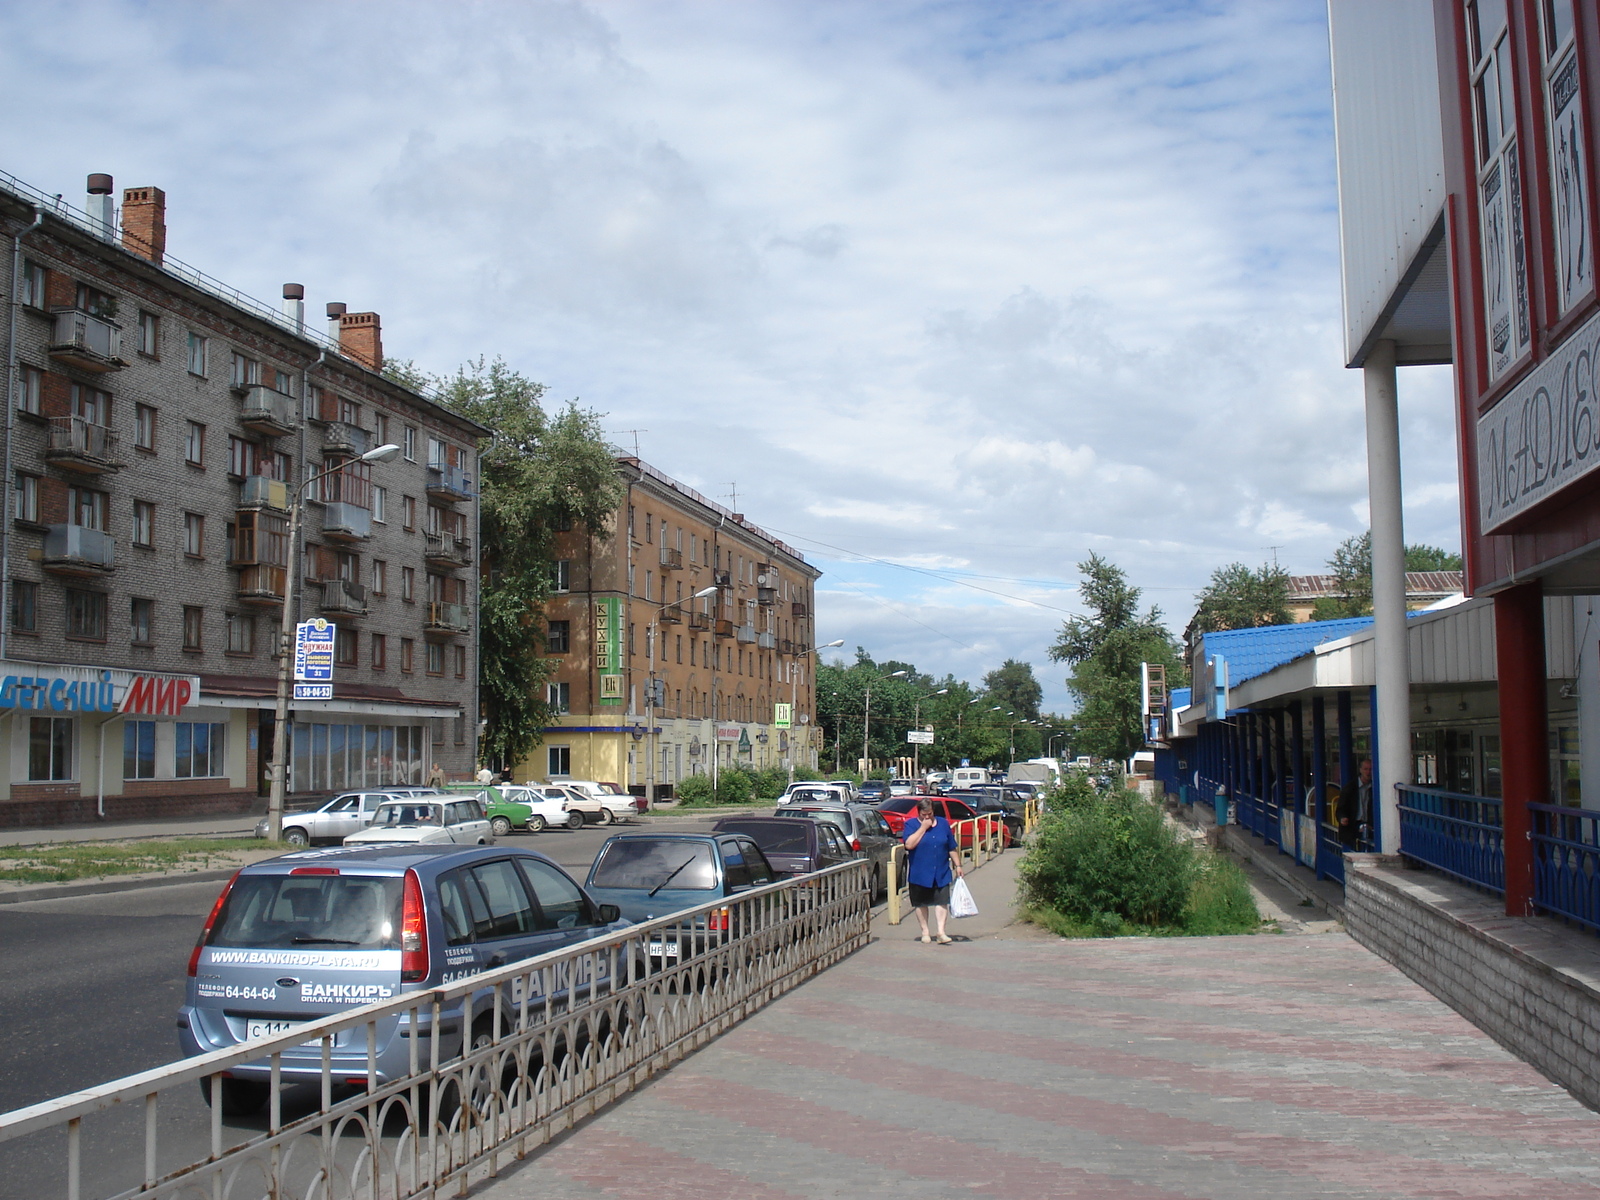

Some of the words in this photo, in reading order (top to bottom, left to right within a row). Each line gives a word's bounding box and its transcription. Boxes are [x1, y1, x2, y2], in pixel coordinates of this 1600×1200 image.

[597, 603, 609, 668] КУХНИ
[296, 626, 307, 674] РЕКЛАМА
[0, 671, 114, 712] ДЕТСКИЙ
[120, 676, 192, 716] МИР
[444, 947, 473, 957] ТЕЛЕФОН
[211, 952, 380, 968] WWW.BANKIROPLATA.RU
[198, 983, 225, 991] ТЕЛЕФОН
[225, 985, 277, 1000] 64-64-64
[301, 983, 392, 998] БАНКИРЪ
[301, 996, 333, 1004] ОПЛАТА
